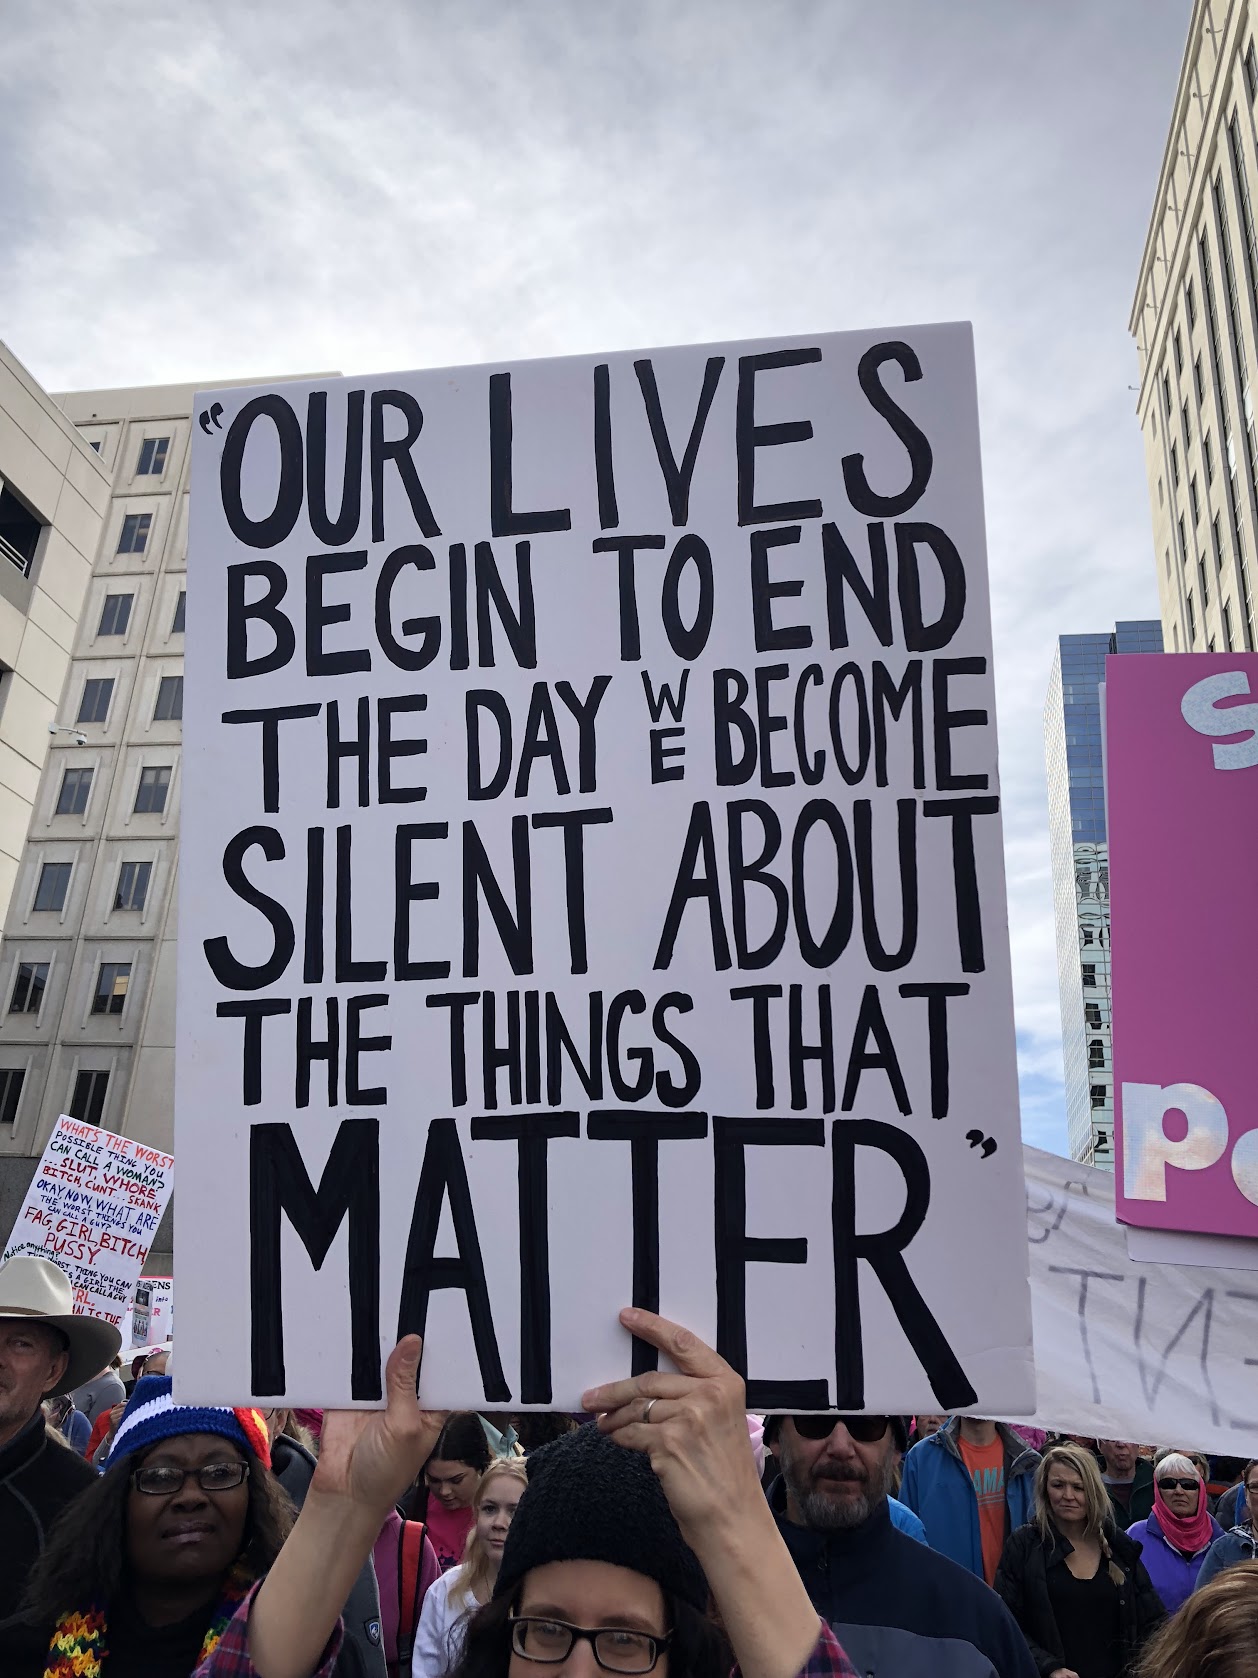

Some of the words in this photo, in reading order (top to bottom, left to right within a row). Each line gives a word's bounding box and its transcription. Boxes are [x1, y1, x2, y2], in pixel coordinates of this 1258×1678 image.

[490, 341, 934, 538] LIVES
[227, 541, 538, 680] BEGIN
[593, 534, 714, 666] TO
[750, 521, 967, 654] END
[222, 694, 428, 813] THE
[466, 674, 613, 800] DAY
[713, 657, 988, 790] BECOME
[203, 807, 614, 991] SILENT
[653, 796, 1000, 974] ABOUT
[216, 993, 393, 1109] THE
[426, 989, 703, 1109] THINGS
[730, 983, 971, 1121] THAT
[60, 1119, 102, 1143] WHAT'S
[105, 1133, 133, 1154] THE
[50, 1141, 72, 1155] CAN
[75, 1149, 99, 1166] CALL
[103, 1161, 113, 1172] A
[117, 1166, 165, 1192] WOMAN?
[55, 1131, 104, 1154] POSSIBLE
[108, 1150, 137, 1167] THING
[144, 1163, 164, 1178] YOU
[42, 1165, 82, 1188] BITCH,
[103, 1173, 156, 1200] WHORE
[24, 1206, 53, 1230] FAG,
[41, 1194, 58, 1206] THE
[63, 1202, 93, 1215] WORST
[96, 1212, 126, 1229] THINGS
[129, 1223, 142, 1235] YOU
[90, 1219, 111, 1231] GUY?
[97, 1198, 136, 1221] WHAT
[136, 1212, 159, 1230] ARE
[26, 1242, 60, 1260] anything?
[43, 1232, 101, 1266] PUSSY.
[74, 1282, 89, 1290] CAN
[75, 1265, 98, 1277] THING
[100, 1273, 114, 1284] YOU
[116, 1279, 132, 1289] CAN
